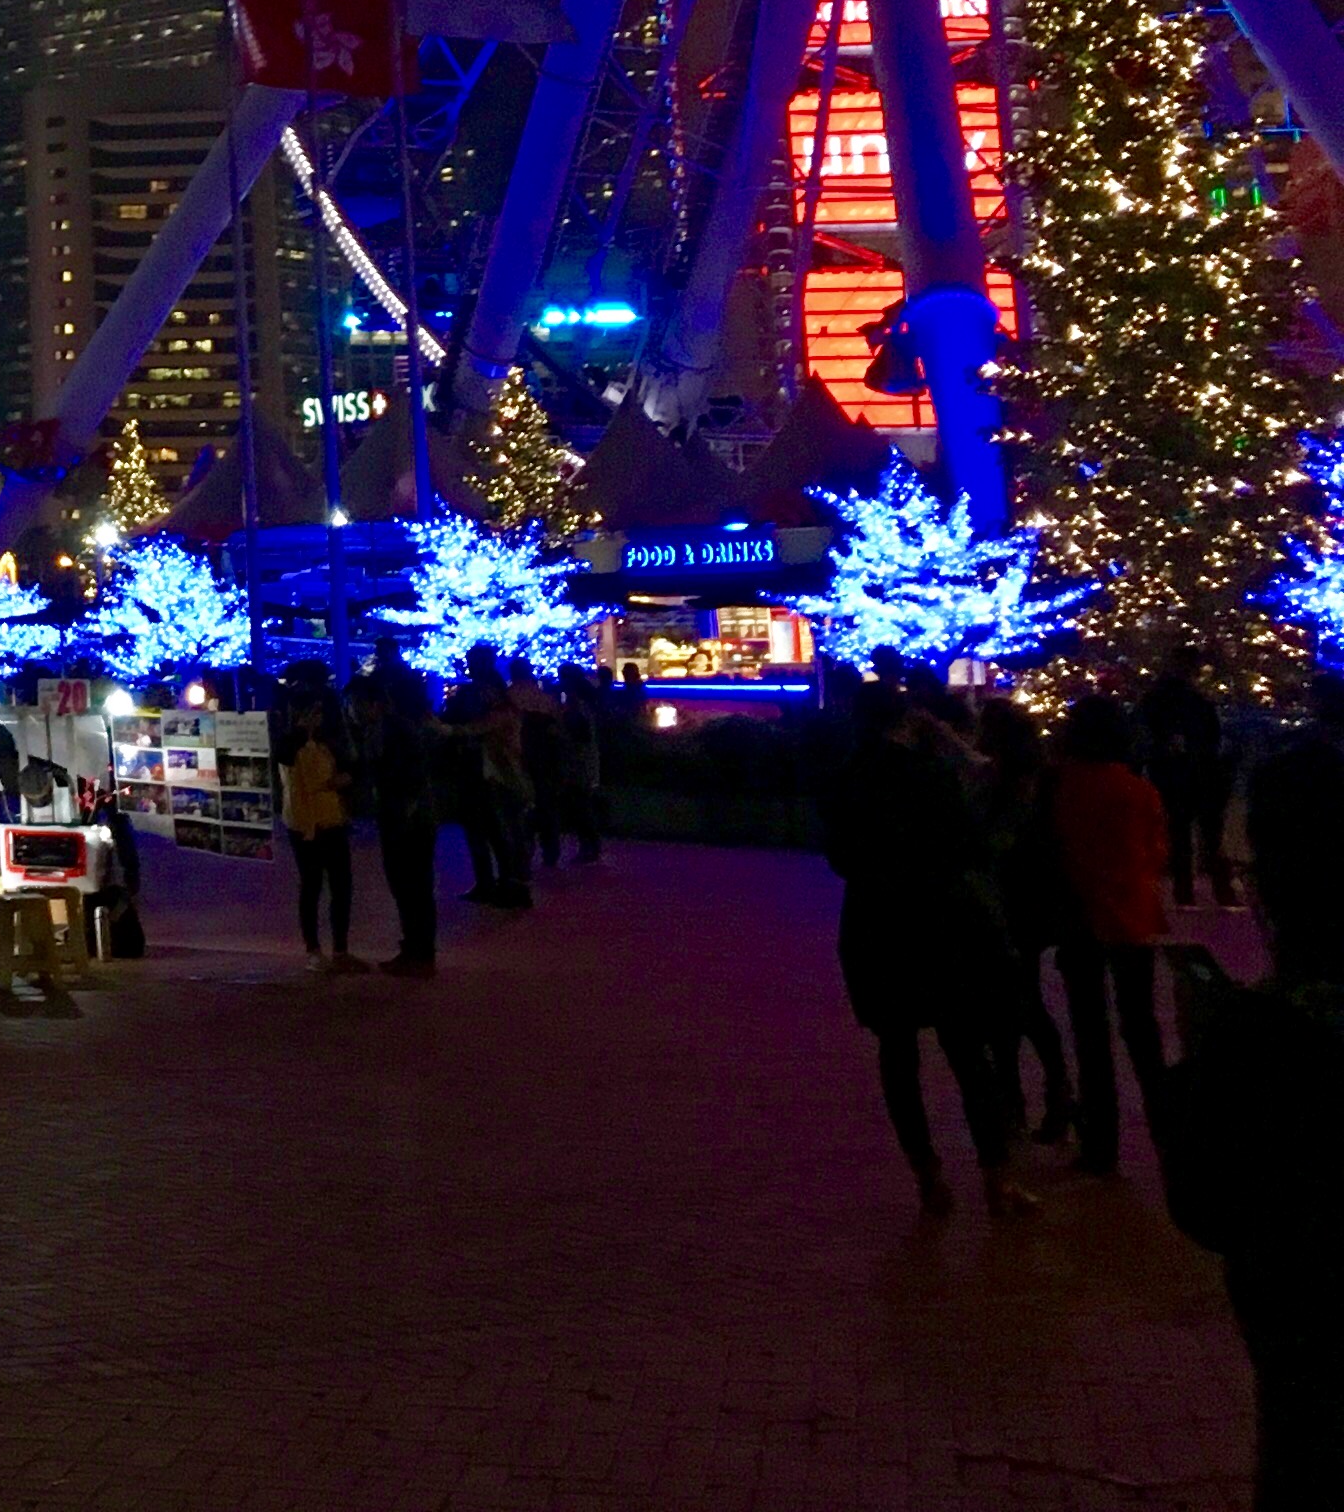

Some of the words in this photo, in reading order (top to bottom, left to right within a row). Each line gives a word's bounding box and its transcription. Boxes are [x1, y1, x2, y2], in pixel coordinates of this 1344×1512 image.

[626, 545, 676, 568] FOOD
[701, 539, 774, 565] DRINKS
[56, 679, 89, 717] 20
